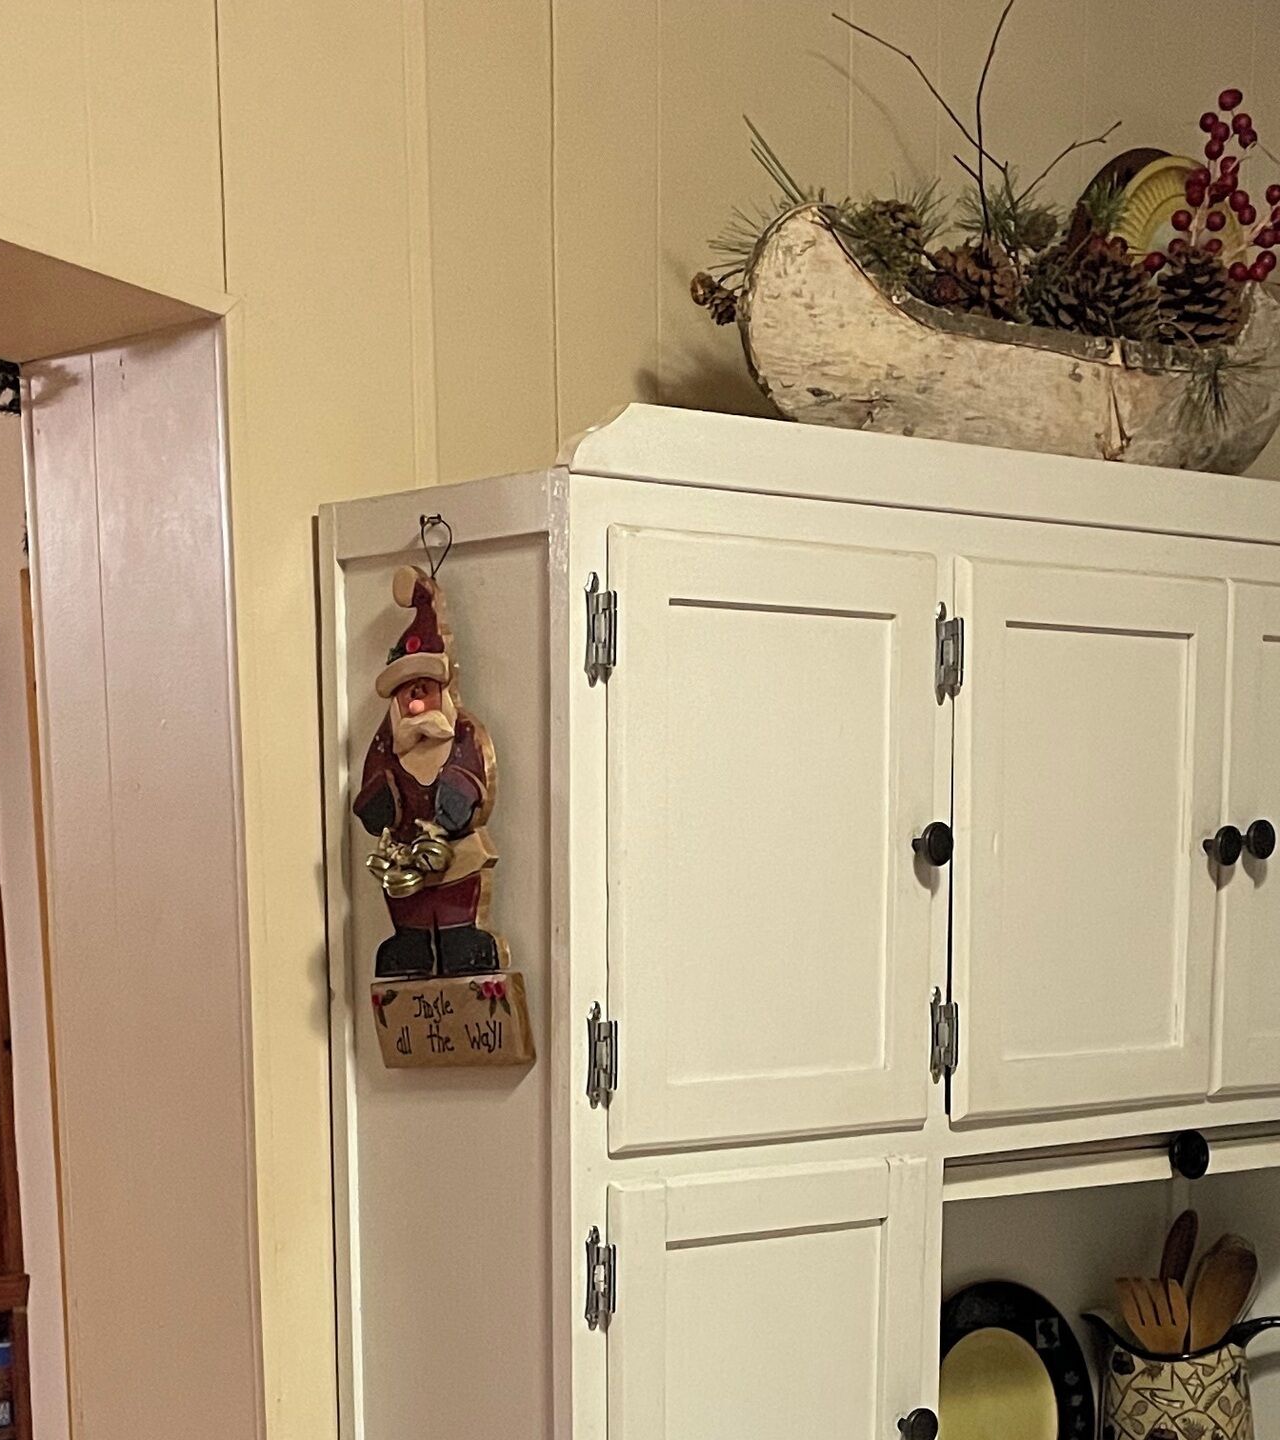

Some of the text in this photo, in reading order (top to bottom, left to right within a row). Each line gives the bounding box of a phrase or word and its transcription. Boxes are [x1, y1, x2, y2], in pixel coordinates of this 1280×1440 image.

[413, 992, 454, 1023] Jingle
[396, 1026, 412, 1055] all
[427, 1025, 455, 1053] the
